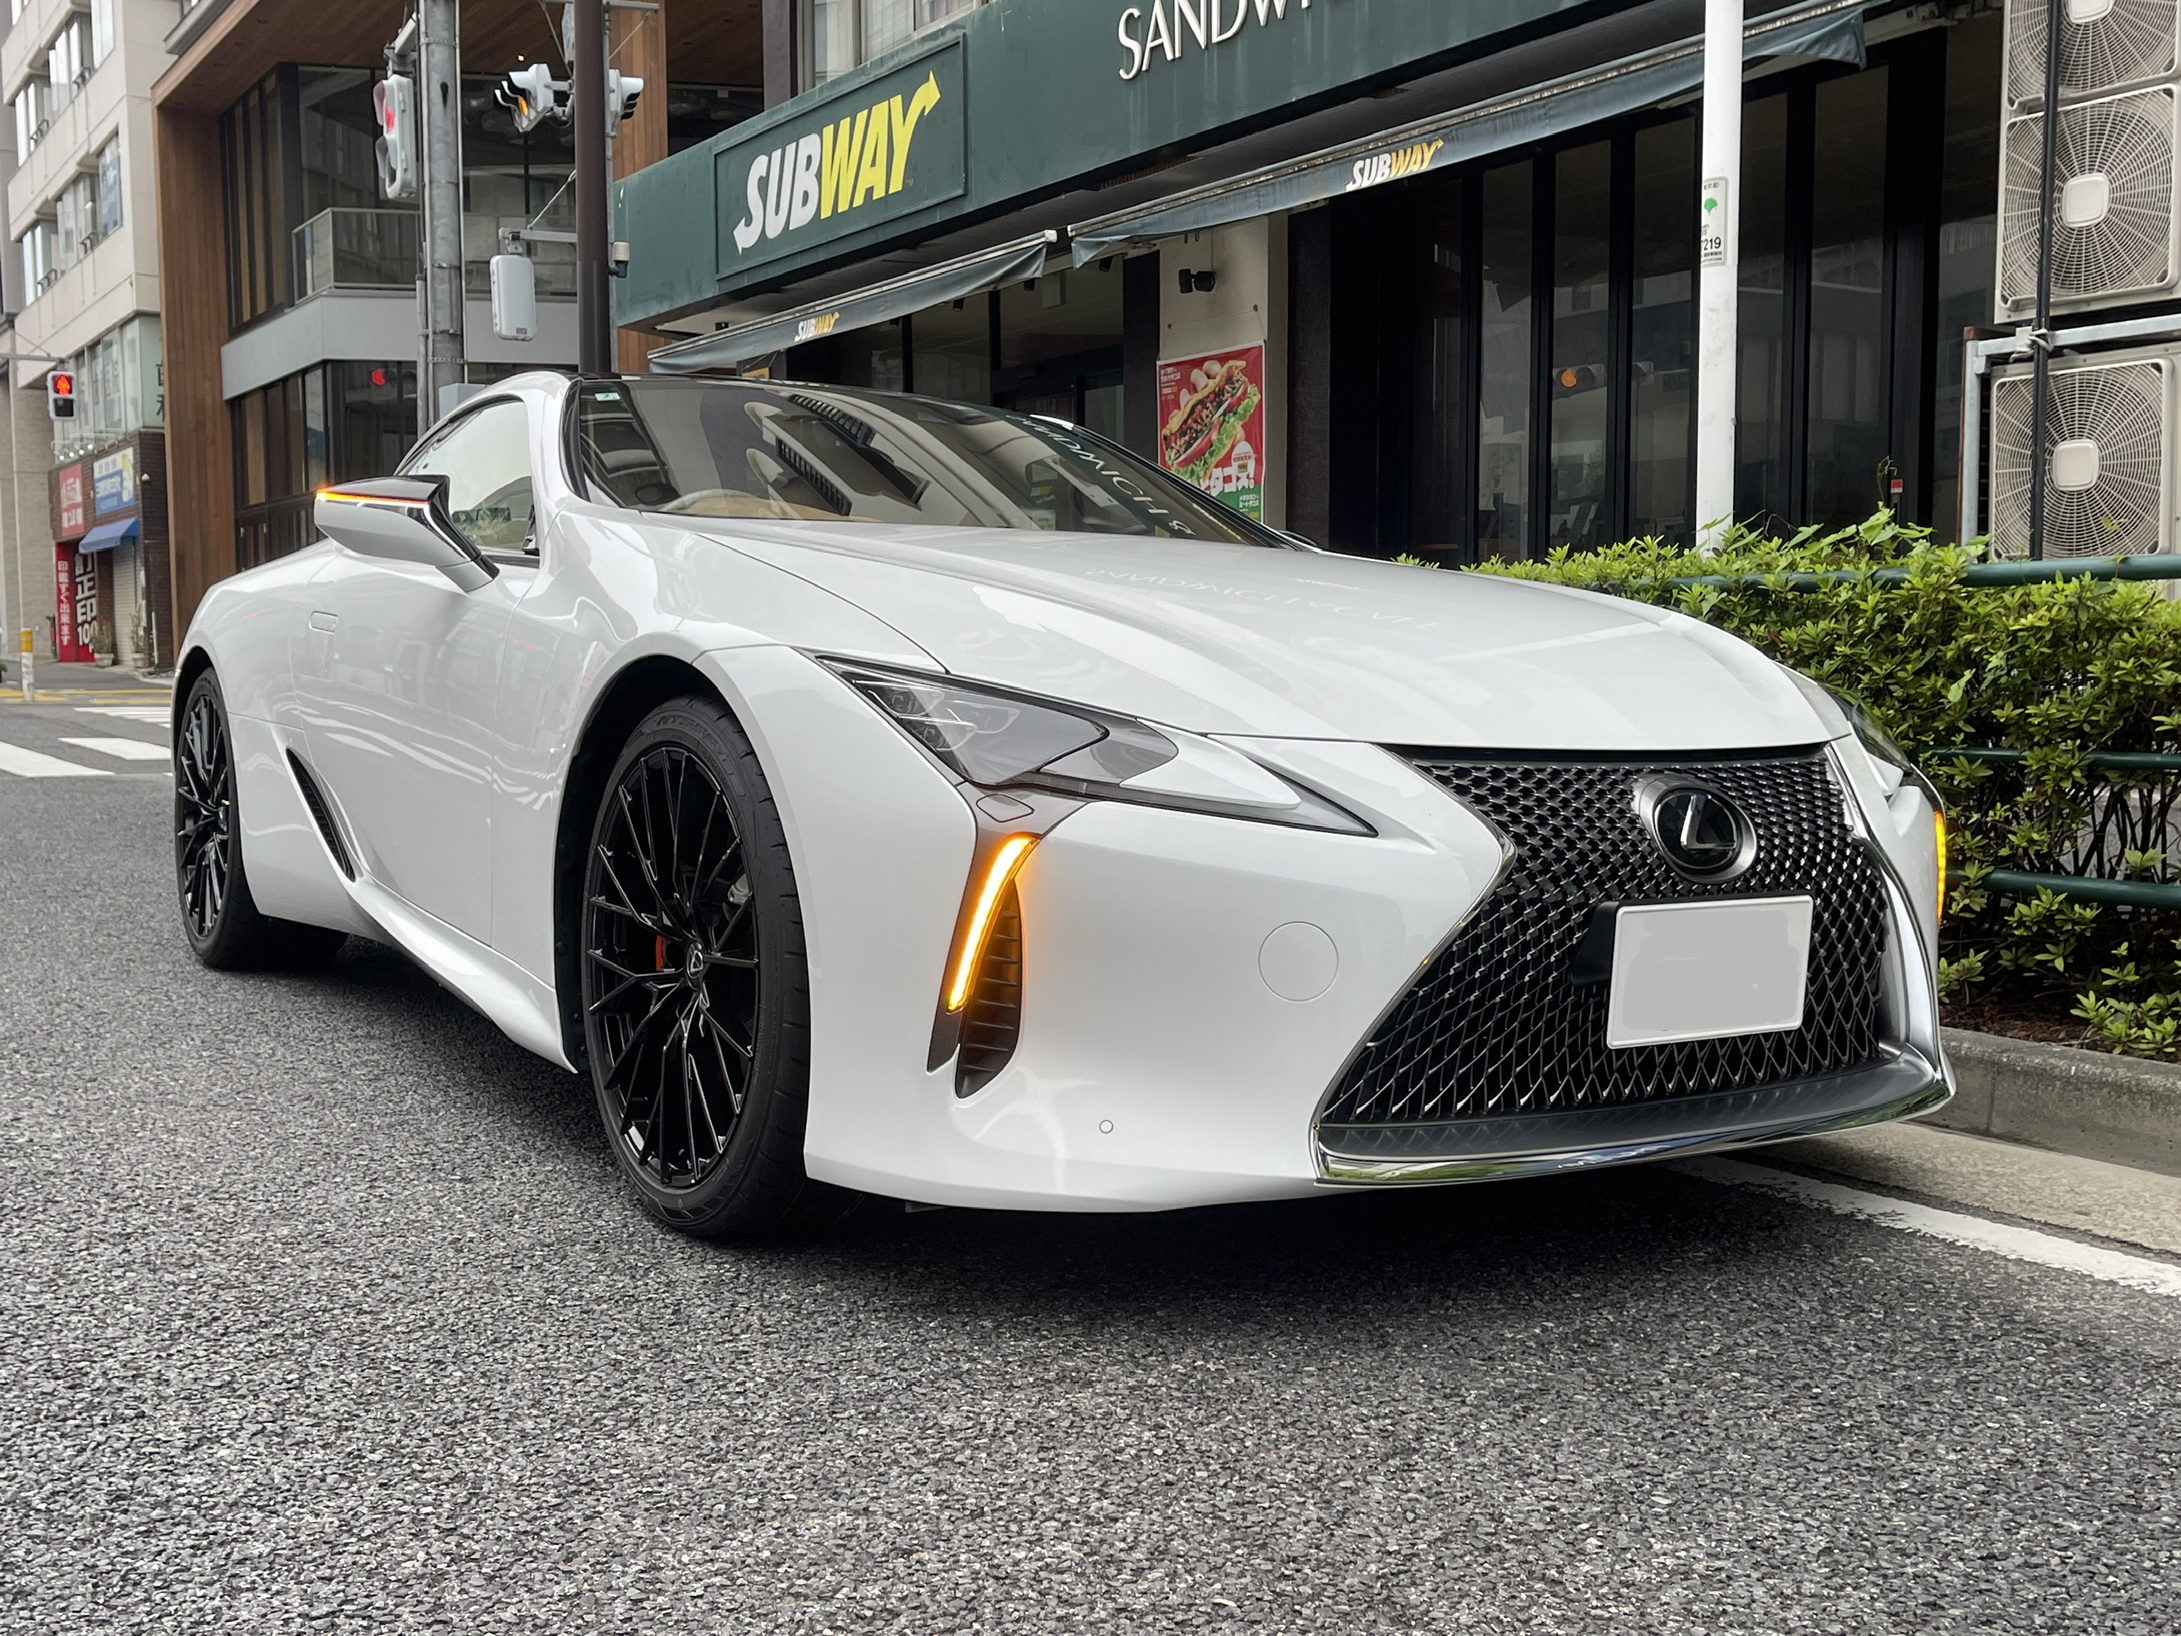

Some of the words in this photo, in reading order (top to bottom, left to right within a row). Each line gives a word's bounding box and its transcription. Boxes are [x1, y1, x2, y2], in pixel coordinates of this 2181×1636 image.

[1118, 0, 1310, 80] SAND
[733, 70, 941, 255] SUBWAY
[1345, 137, 1444, 192] SUBWAY
[794, 311, 840, 342] SUBWAY
